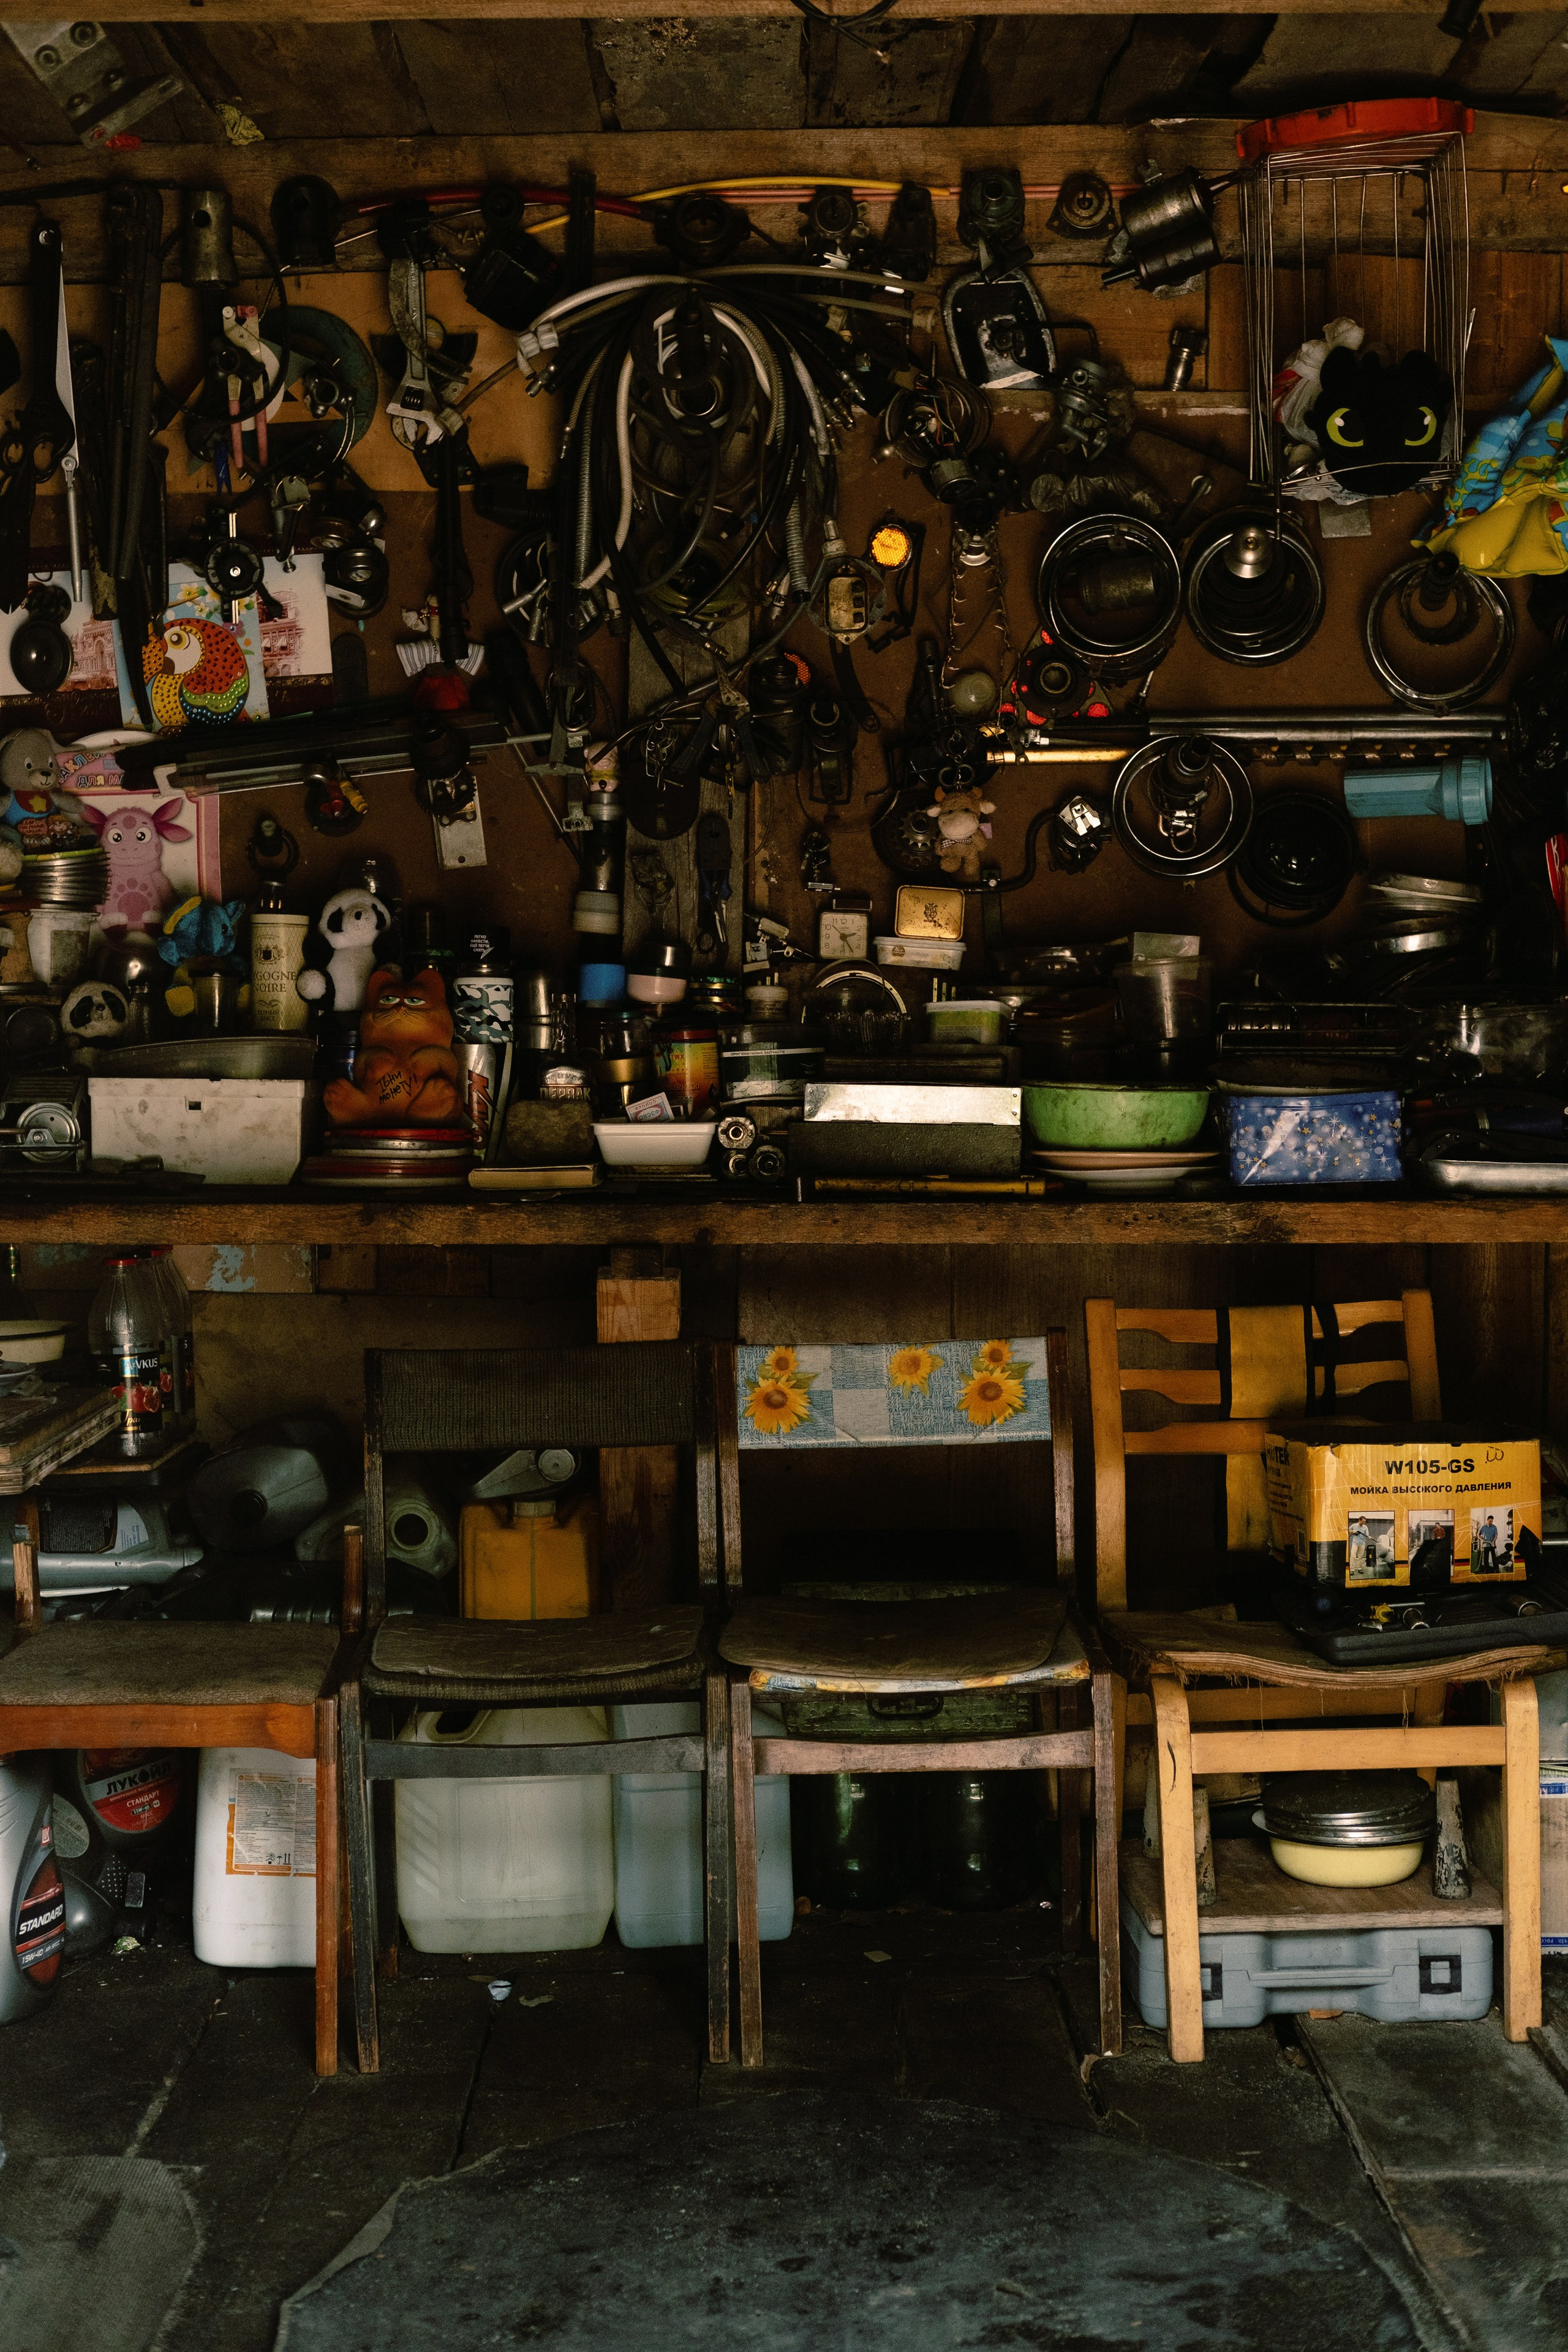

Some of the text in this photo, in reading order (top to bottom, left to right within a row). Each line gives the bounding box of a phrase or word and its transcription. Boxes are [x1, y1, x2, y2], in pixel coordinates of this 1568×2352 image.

[77, 775, 105, 788] ДЛЯ
[251, 971, 296, 981] IGOGNE
[1385, 1458, 1475, 1475] W105-GS
[1350, 1482, 1512, 1494] МОЙКА ВЫСОКОГО ДАВЛЕНИЯ
[126, 1790, 160, 1807] СТАНДАРТ
[133, 1805, 151, 1814] 15W-40
[19, 1904, 64, 1936] STANDARD
